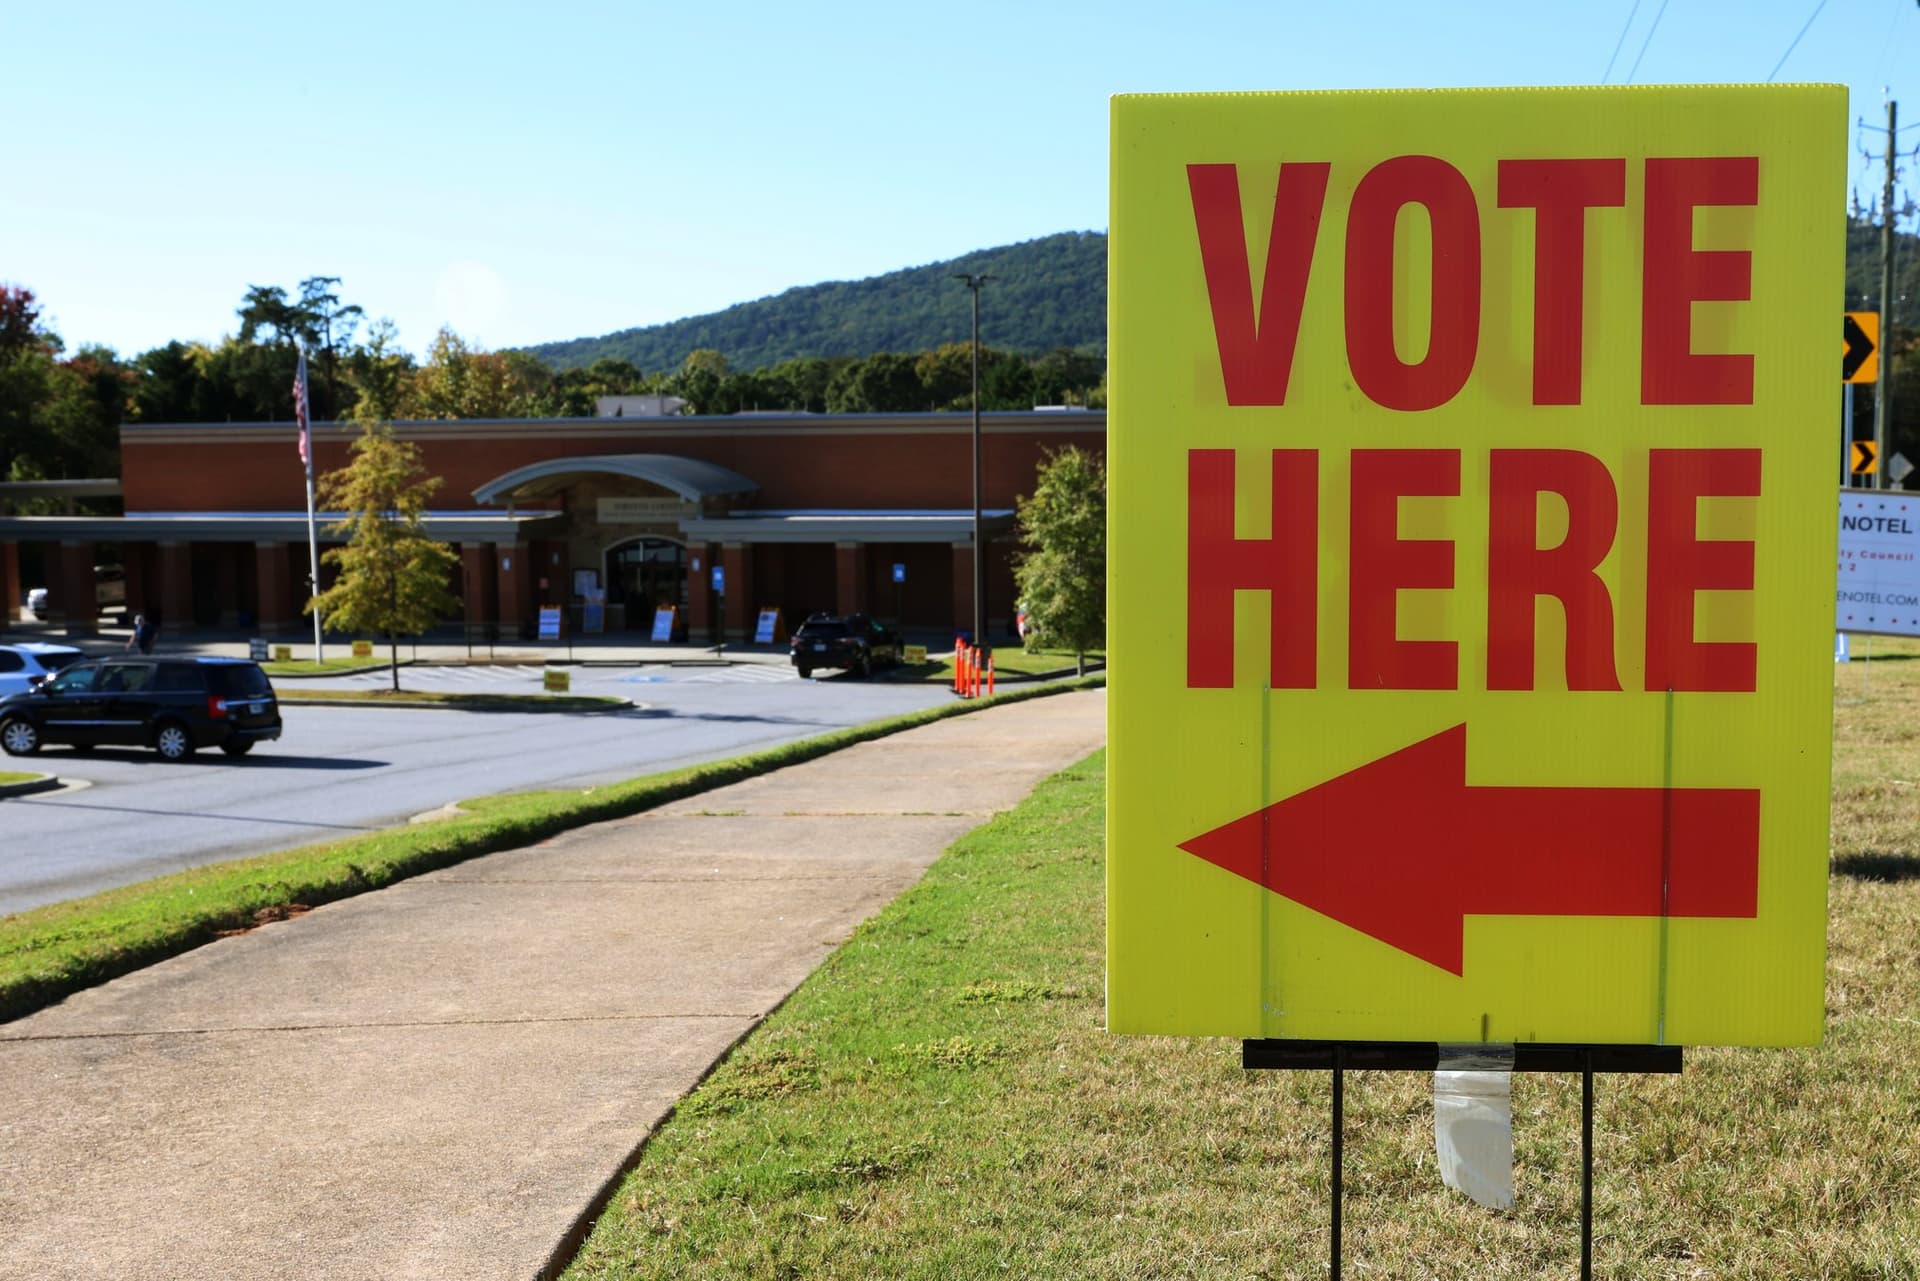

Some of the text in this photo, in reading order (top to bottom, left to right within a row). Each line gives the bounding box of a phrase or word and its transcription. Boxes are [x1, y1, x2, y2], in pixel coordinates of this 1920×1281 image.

[1186, 155, 1759, 412] VOTE
[1842, 516, 1912, 534] NOTEL
[1840, 550, 1914, 560] ty Council
[1186, 448, 1762, 692] HERE
[1849, 563, 1856, 572] 2
[1836, 591, 1919, 606] ENOTEL.COM
